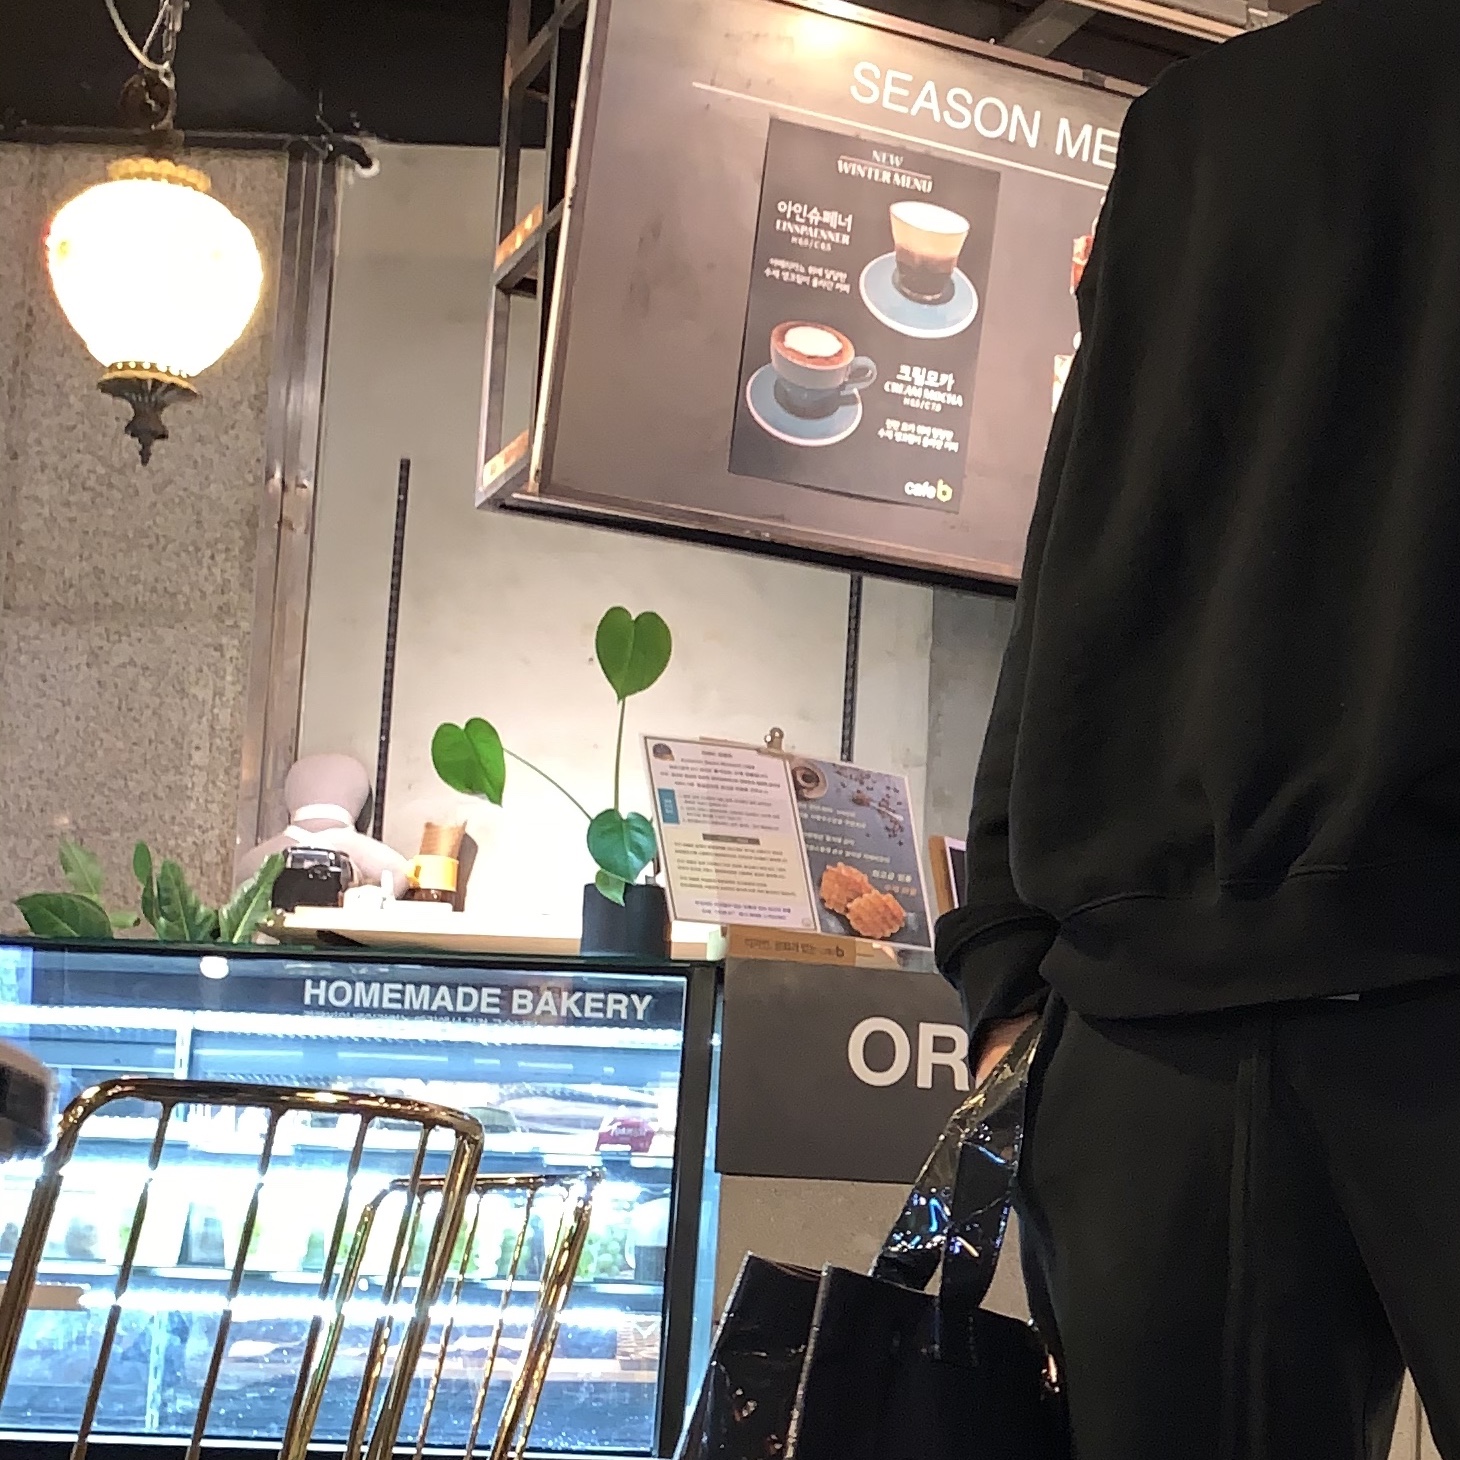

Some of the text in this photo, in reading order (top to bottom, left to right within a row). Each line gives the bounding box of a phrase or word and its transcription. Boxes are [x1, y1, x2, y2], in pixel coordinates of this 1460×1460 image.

[850, 61, 1041, 148] SEASON
[872, 150, 903, 167] NEW
[837, 159, 934, 194] WINTER MENU
[777, 200, 852, 232] 아인슈페너
[896, 364, 955, 391] 크림모카
[303, 979, 653, 1021] HOMEMADE BAKERY
